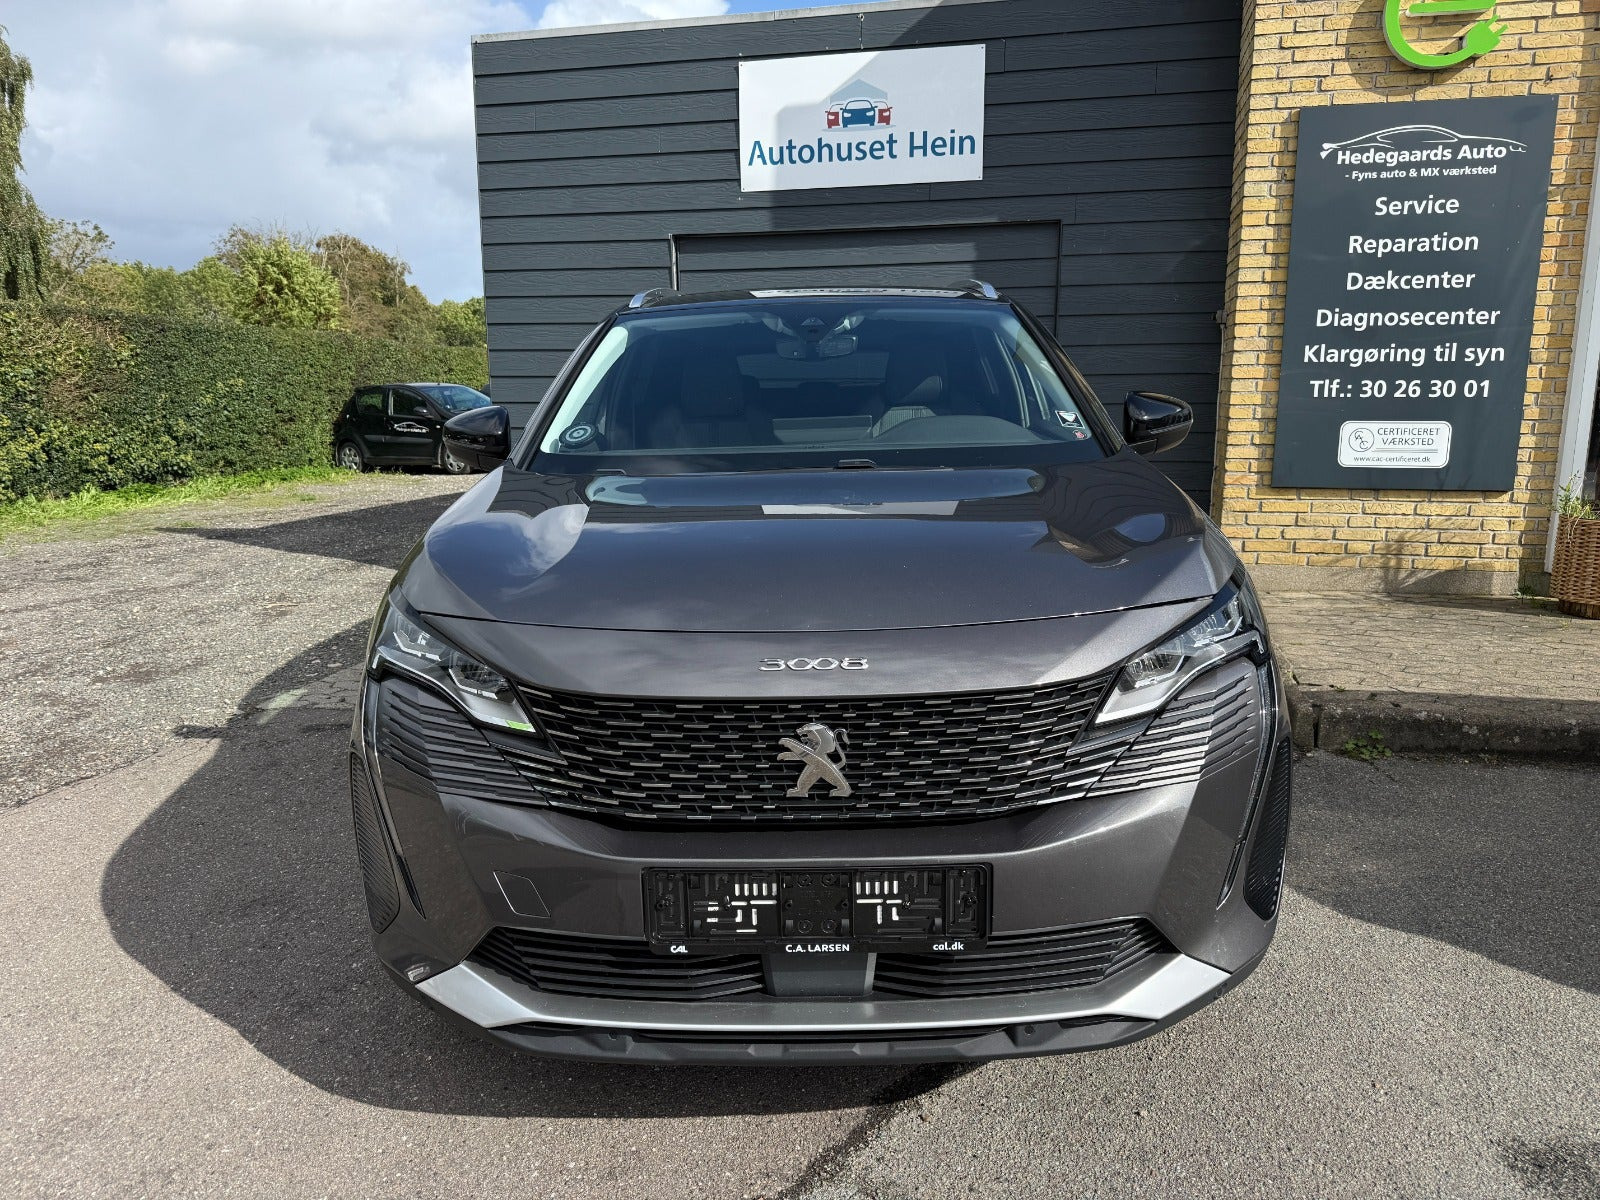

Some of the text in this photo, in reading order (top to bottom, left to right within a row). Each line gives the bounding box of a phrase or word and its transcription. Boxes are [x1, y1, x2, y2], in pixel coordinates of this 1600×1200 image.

[748, 129, 976, 167] Autohuset Hein
[1336, 145, 1507, 167] Hedegaards Auto
[1351, 170, 1378, 182] Fyns
[1380, 171, 1406, 179] auto
[1408, 168, 1418, 178] &
[1420, 168, 1440, 177] MX
[1442, 165, 1497, 176] værksted
[1374, 195, 1460, 216] Service
[1348, 232, 1479, 258] Reparation
[1346, 270, 1476, 291] Dækcenter
[1316, 307, 1501, 331] Diagnosecenter
[1303, 343, 1505, 367] Klargøring til syn
[1310, 380, 1490, 398] Tlf.: 30 26 30 01
[1377, 427, 1440, 436] CERTIFICERET
[1382, 437, 1434, 446] VÆRKSTED
[759, 657, 869, 671] 3008
[670, 945, 689, 954] CAL
[785, 943, 850, 953] C.A. LARSEN
[932, 941, 965, 951] cal.dk
